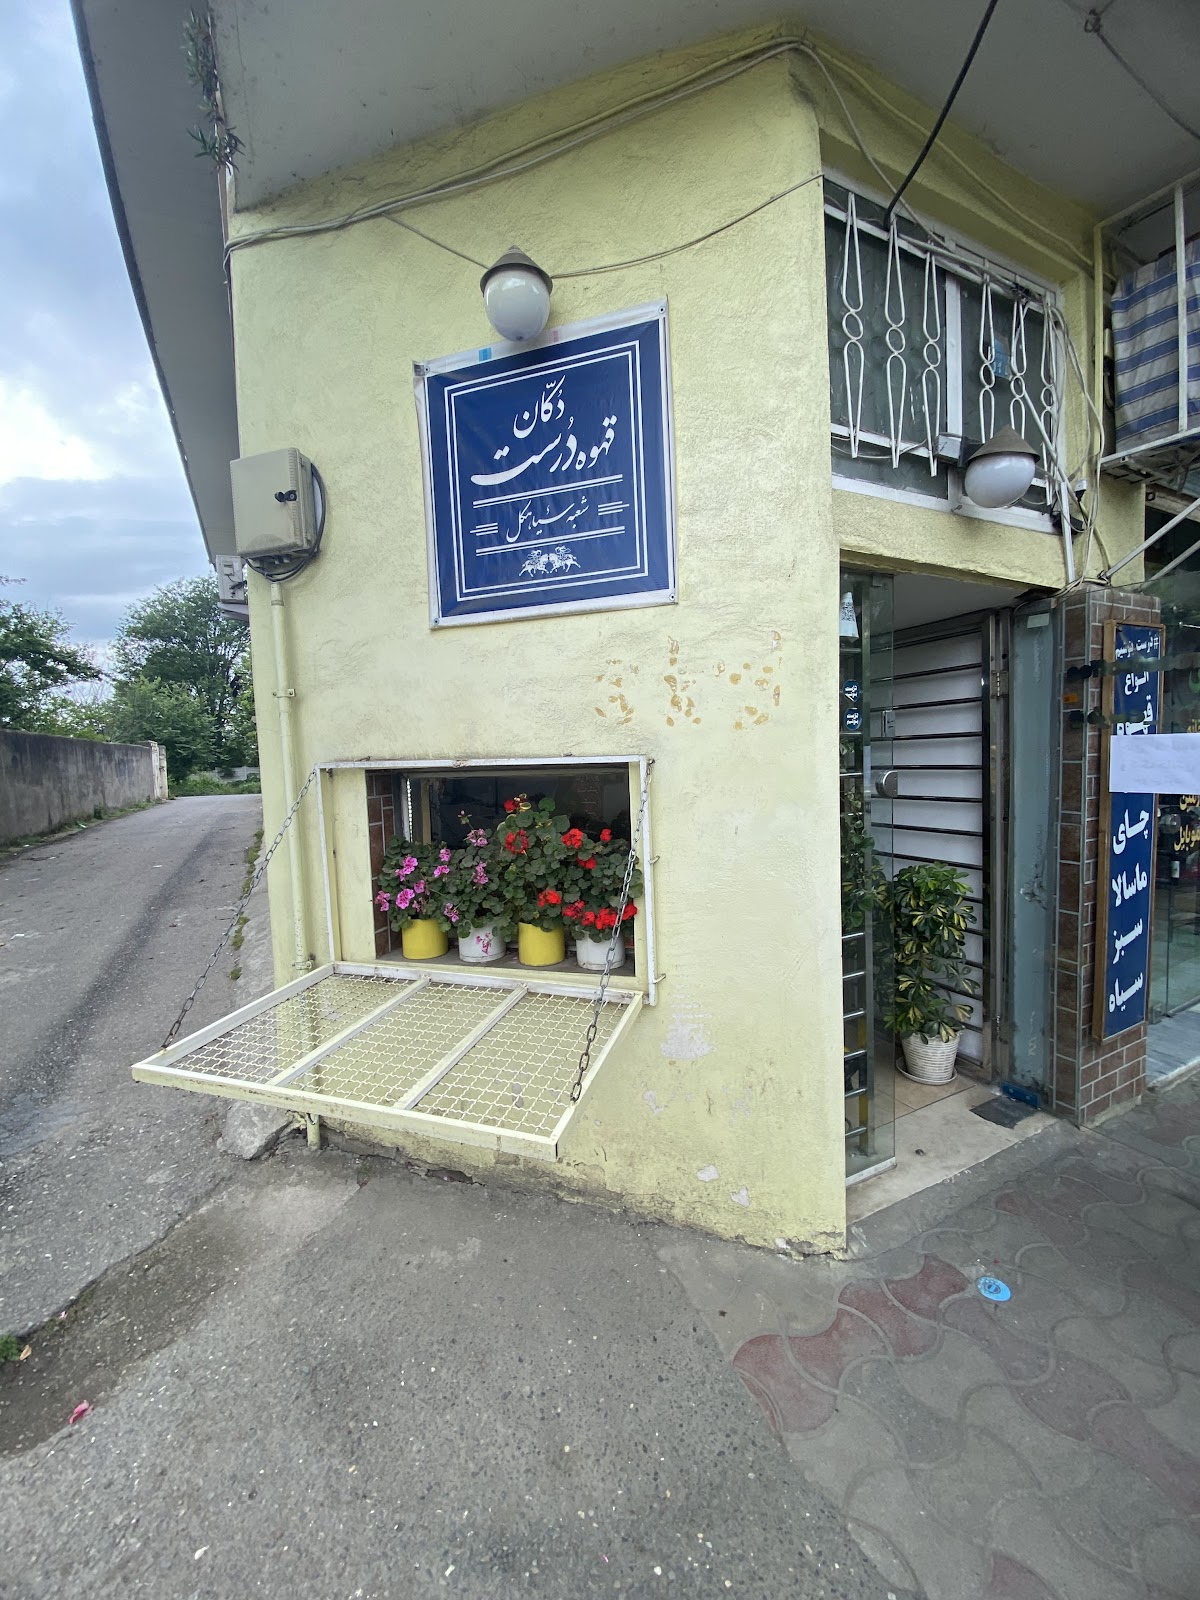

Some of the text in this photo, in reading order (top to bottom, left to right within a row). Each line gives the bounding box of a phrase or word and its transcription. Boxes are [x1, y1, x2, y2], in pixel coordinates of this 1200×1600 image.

[575, 415, 618, 470] قهوه
[1112, 808, 1150, 855] چای
[1111, 862, 1148, 908] ماسالا
[1112, 918, 1143, 965] سبز
[1108, 972, 1144, 1013] سیاه
